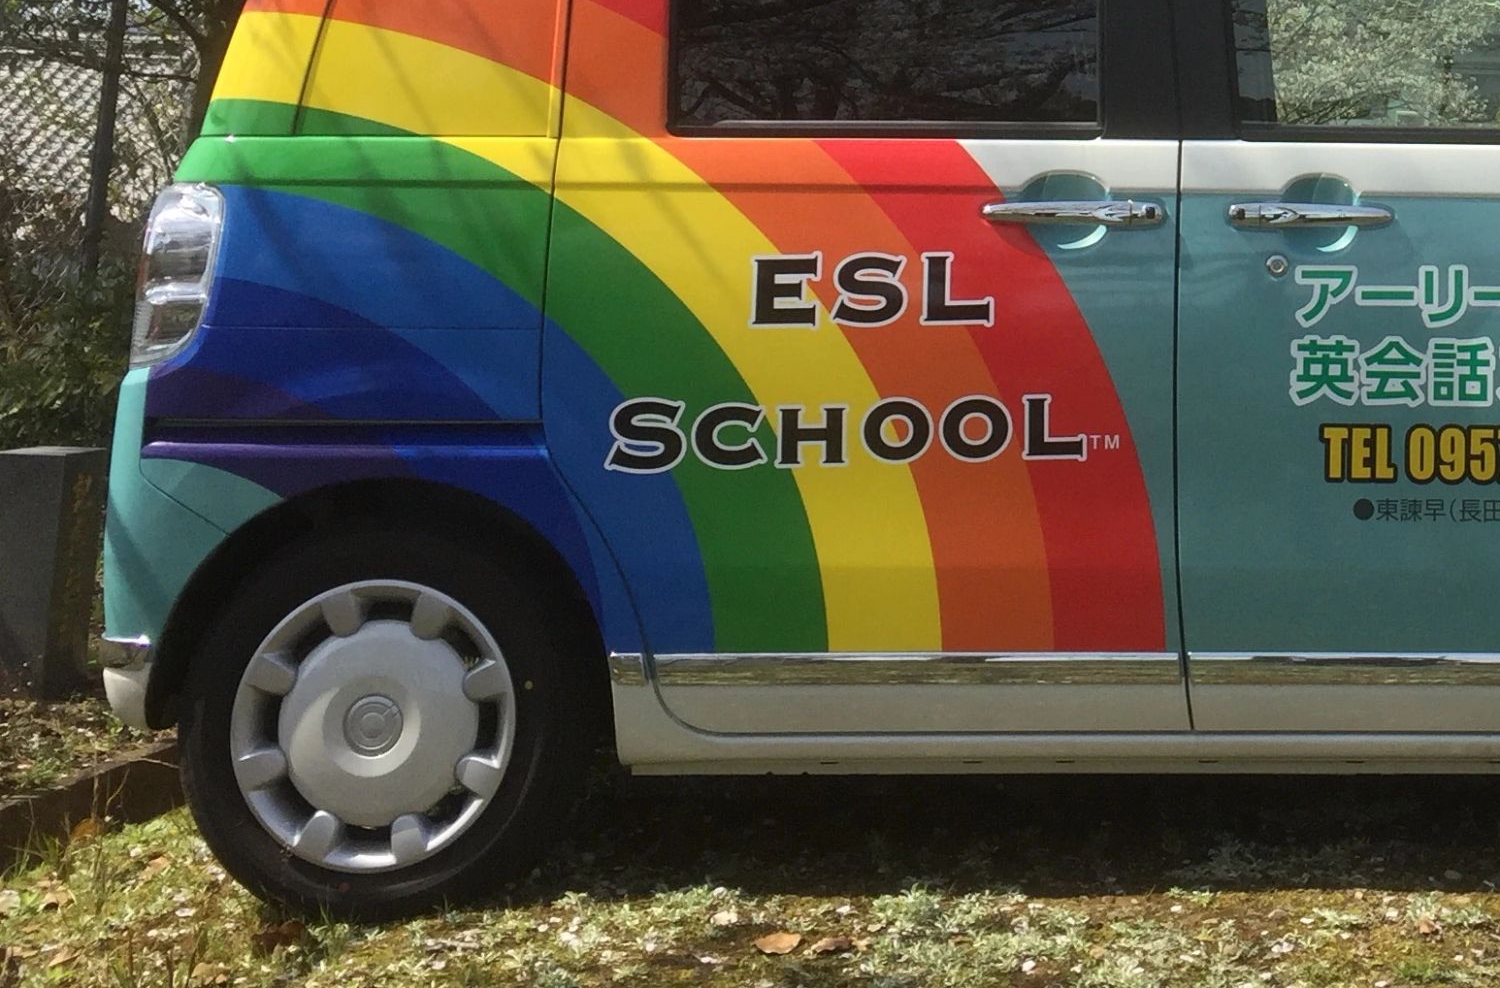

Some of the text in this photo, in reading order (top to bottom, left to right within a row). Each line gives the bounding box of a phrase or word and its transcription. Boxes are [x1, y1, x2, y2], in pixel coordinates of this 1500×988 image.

[750, 251, 994, 328] ESL
[604, 394, 1086, 474] SCHOOL
[1320, 424, 1397, 484] TEL
